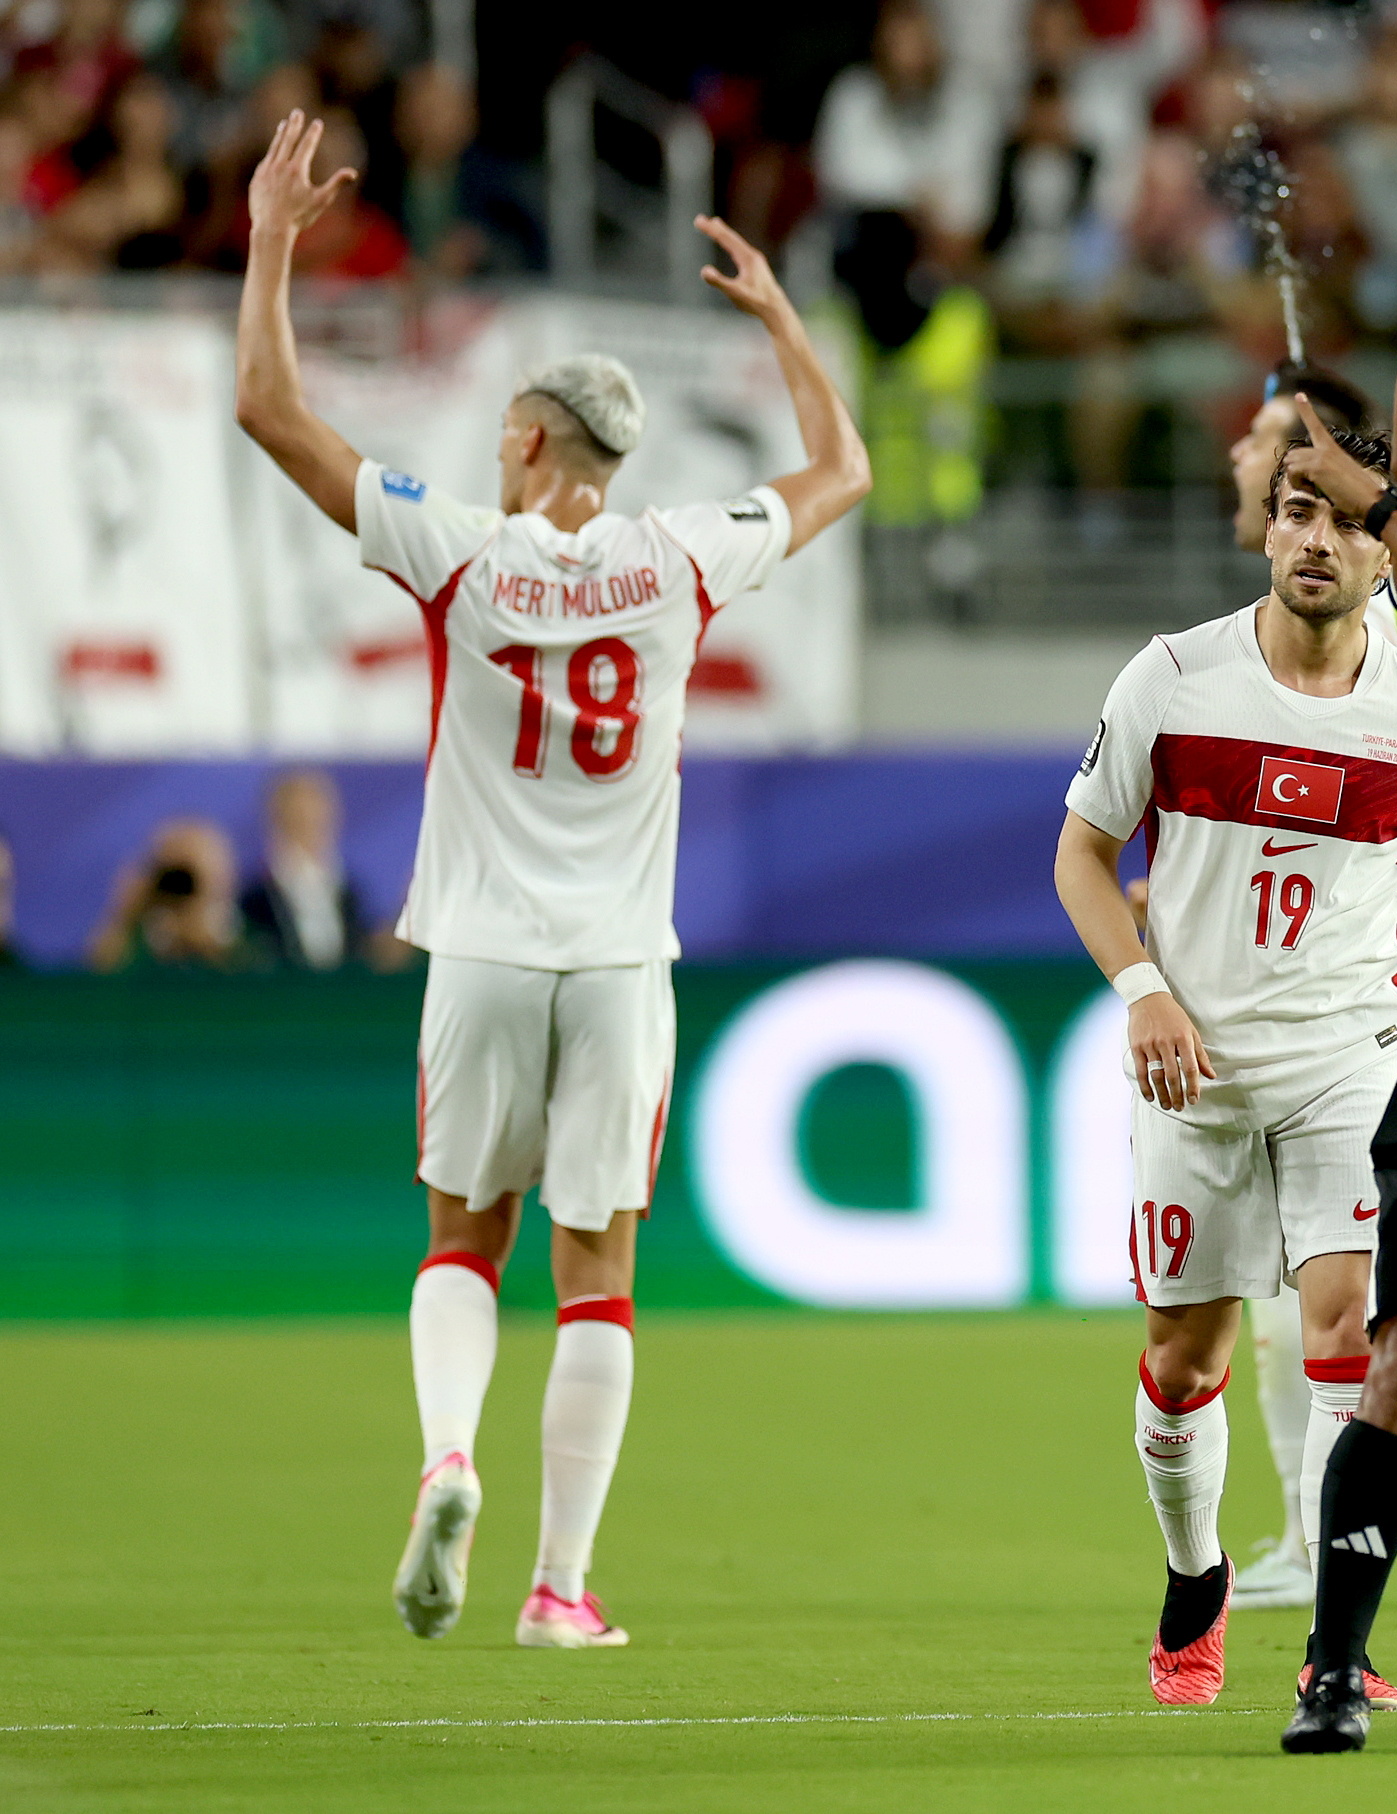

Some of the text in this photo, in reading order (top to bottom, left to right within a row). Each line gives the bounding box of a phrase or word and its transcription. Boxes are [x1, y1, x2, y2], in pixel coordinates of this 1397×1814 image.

[491, 563, 662, 618] MERT MÜLDÜR
[487, 637, 646, 784] 18
[1250, 871, 1315, 951] 19
[1142, 1200, 1194, 1279] 19
